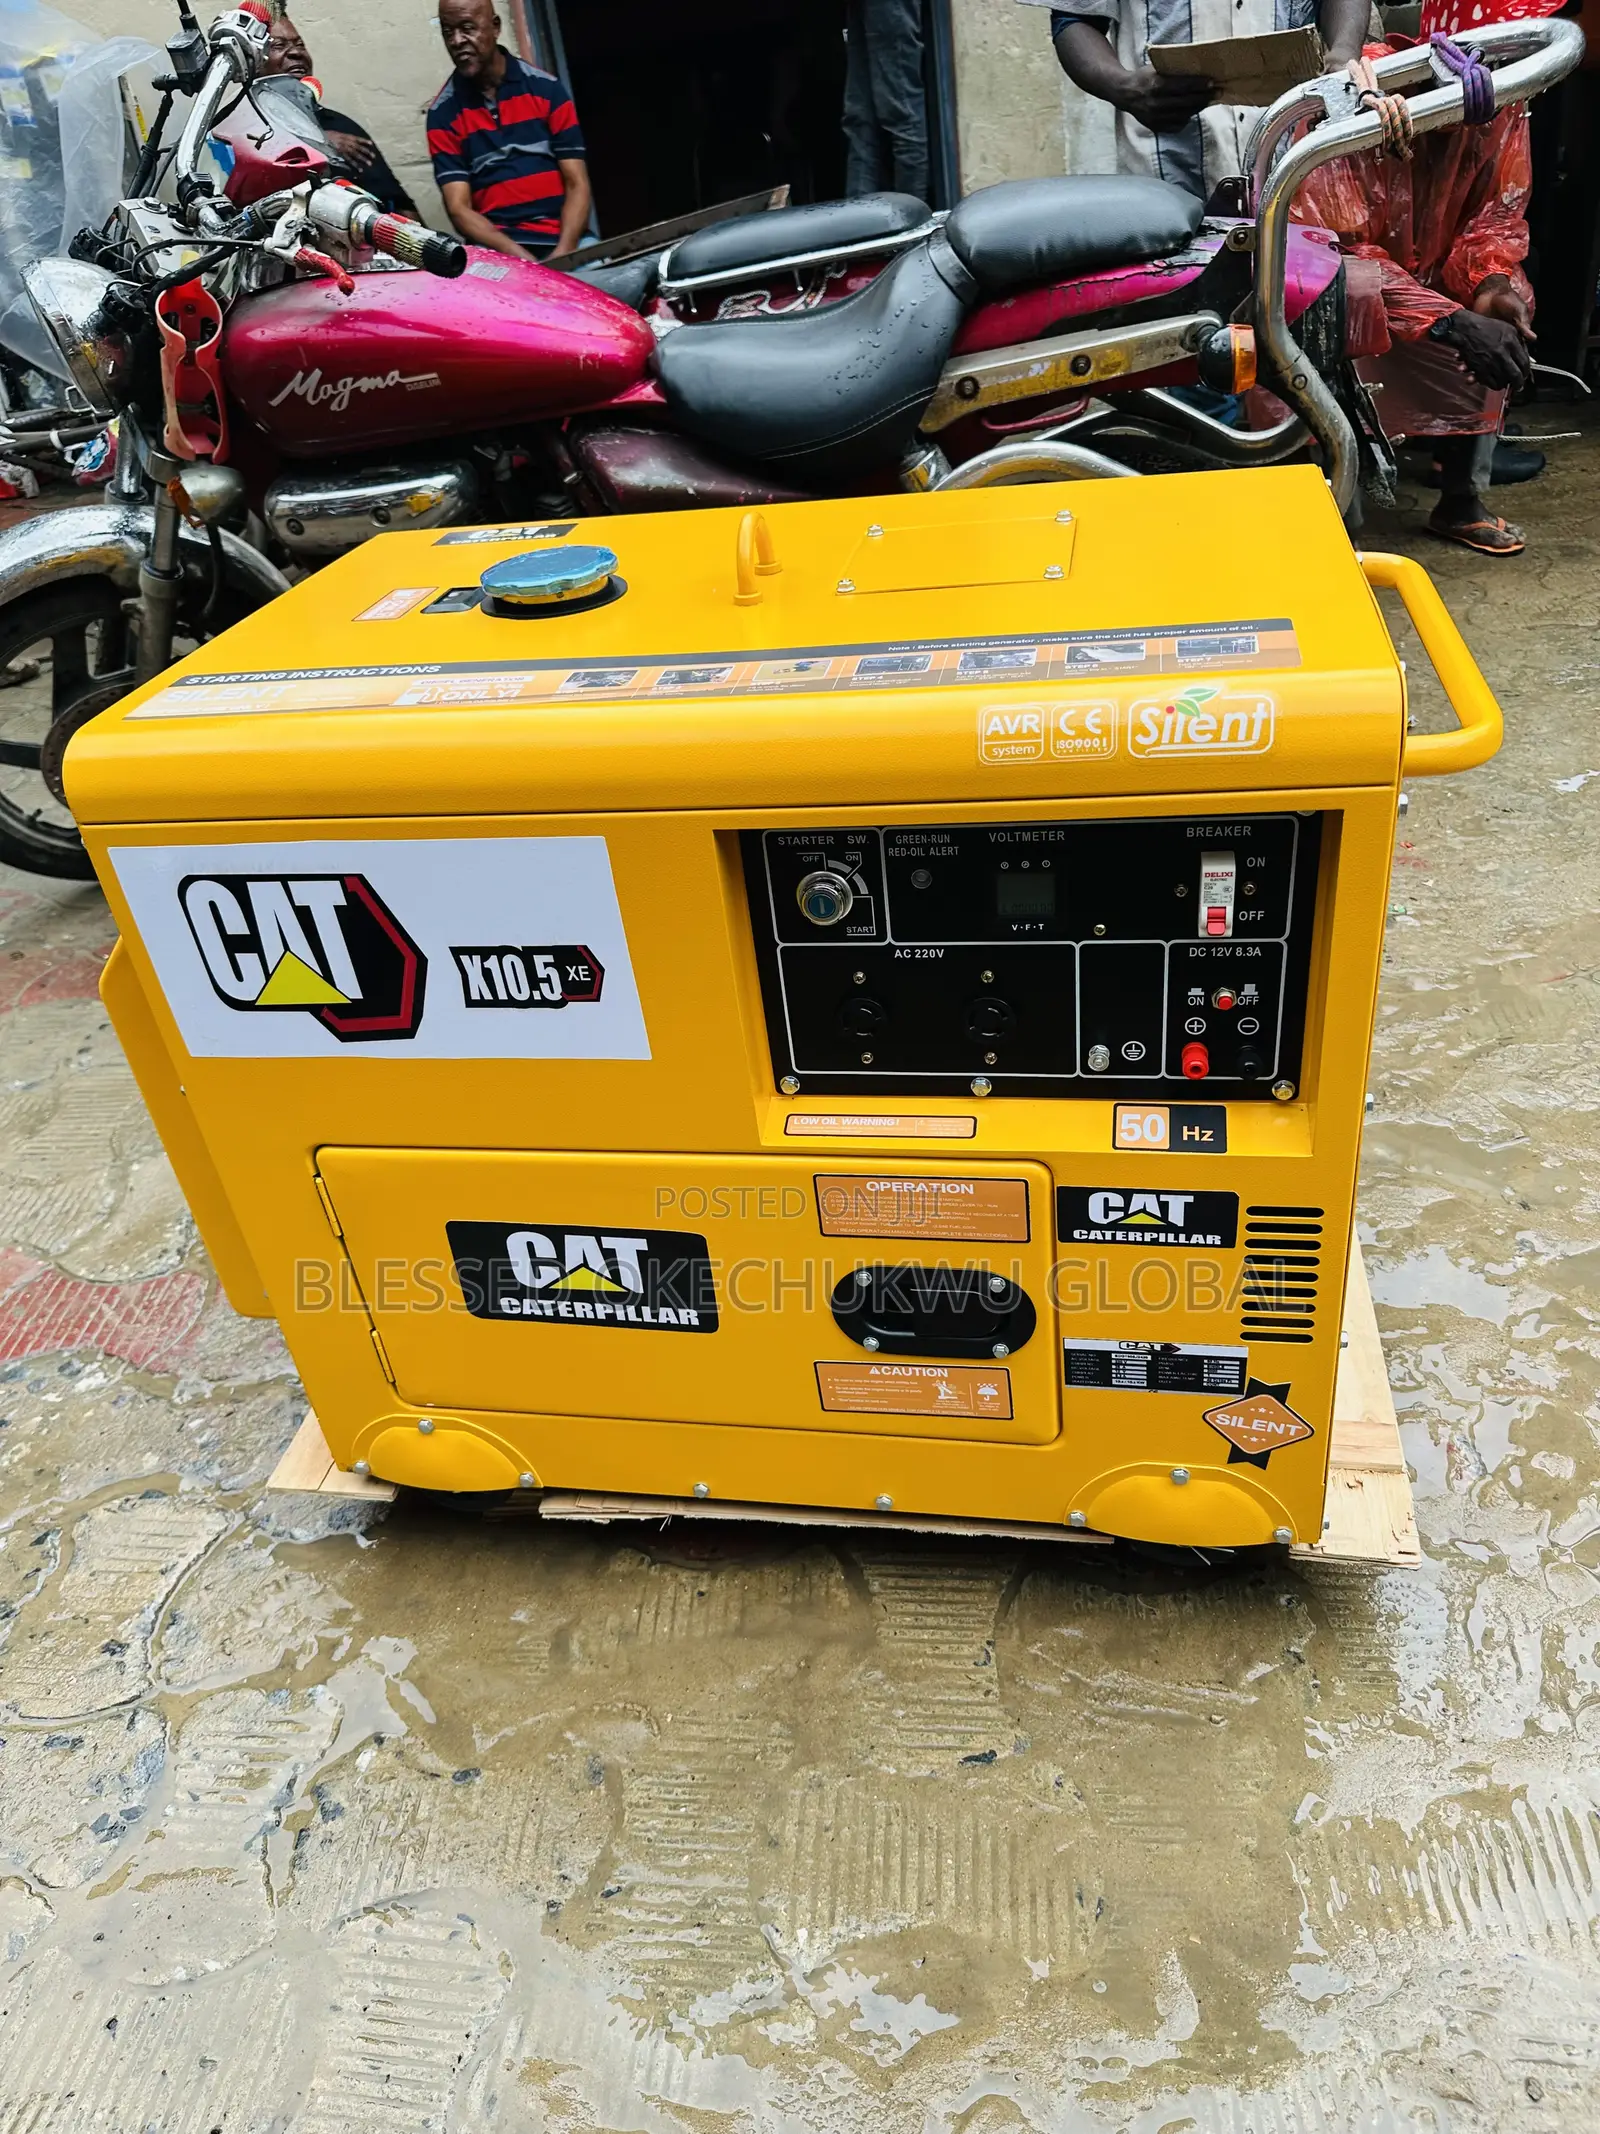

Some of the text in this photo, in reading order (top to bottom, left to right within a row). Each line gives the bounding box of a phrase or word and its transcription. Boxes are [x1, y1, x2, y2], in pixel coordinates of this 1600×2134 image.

[267, 367, 438, 411] Magma
[468, 526, 549, 539] CAT
[951, 641, 987, 649] starting
[988, 638, 1035, 647] generator
[1154, 628, 1187, 637] proper
[1189, 626, 1223, 634] amount
[186, 664, 443, 684] STARTING INSTRUCTIONS
[164, 684, 297, 702] SILENT
[986, 713, 1041, 737] AVR
[1135, 702, 1268, 745] Silent
[991, 744, 1035, 758] system
[988, 830, 1065, 842] VOLTMETER
[1186, 825, 1252, 838] BREAKER
[777, 834, 870, 846] STARTER SW.
[895, 834, 951, 845] GREEN-RUN
[845, 854, 859, 862] ON
[888, 846, 960, 857] RED-OIL ALERT
[802, 855, 819, 863] OFF
[1246, 856, 1266, 867] ON
[1238, 910, 1265, 922] OFF
[846, 926, 873, 934] START
[185, 879, 363, 1002] CAT
[894, 948, 945, 959] AC 220V
[1189, 946, 1262, 957] DC 12V 8.3A
[459, 954, 591, 1001] X10.5 XE
[1187, 996, 1205, 1006] ON
[1237, 996, 1260, 1006] OFF
[793, 1117, 900, 1126] LOW OIL WARNING!
[1119, 1113, 1215, 1143] 50 Hz
[866, 1180, 975, 1195] OPERATION
[1088, 1191, 1194, 1228] CAT
[1072, 1228, 1221, 1245] CATERPILLAR
[505, 1230, 649, 1294] CAT
[500, 1297, 700, 1326] CATERPILLAR
[1119, 1341, 1165, 1351] CAT
[881, 1366, 949, 1378] CAUTION
[1214, 1413, 1303, 1437] SILENT
